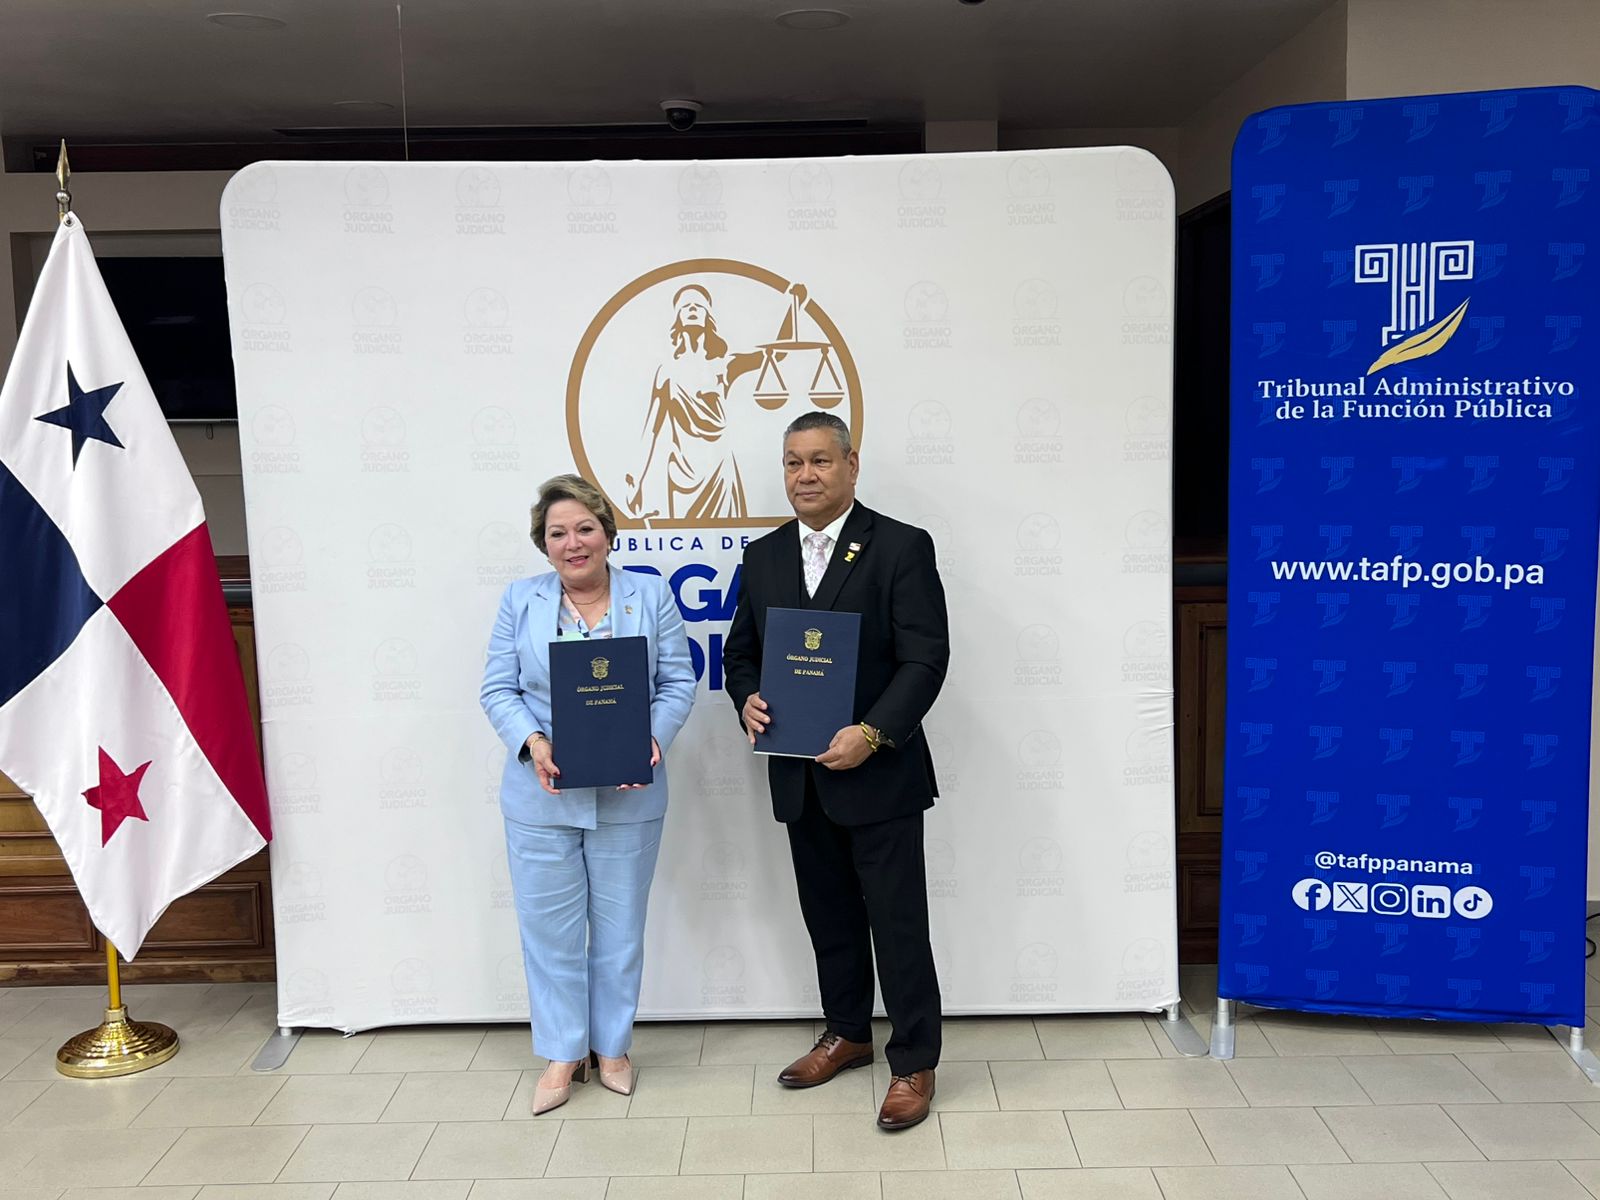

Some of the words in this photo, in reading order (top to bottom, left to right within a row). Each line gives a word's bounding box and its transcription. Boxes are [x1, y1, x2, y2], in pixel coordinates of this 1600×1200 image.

[1258, 377, 1365, 398] Tribunal
[1373, 376, 1574, 396] Administrativo
[1276, 400, 1304, 420] de
[1312, 400, 1334, 419] la
[1342, 399, 1446, 418] Función
[1454, 398, 1552, 418] Pública
[722, 536, 749, 550] DE
[1271, 555, 1544, 590] www.tafp.gob.pa
[786, 653, 809, 662] ÓRGANO
[809, 656, 833, 664] JUDICIAL
[600, 684, 624, 692] JUDICIAL
[1314, 851, 1473, 875] @tafppanama
